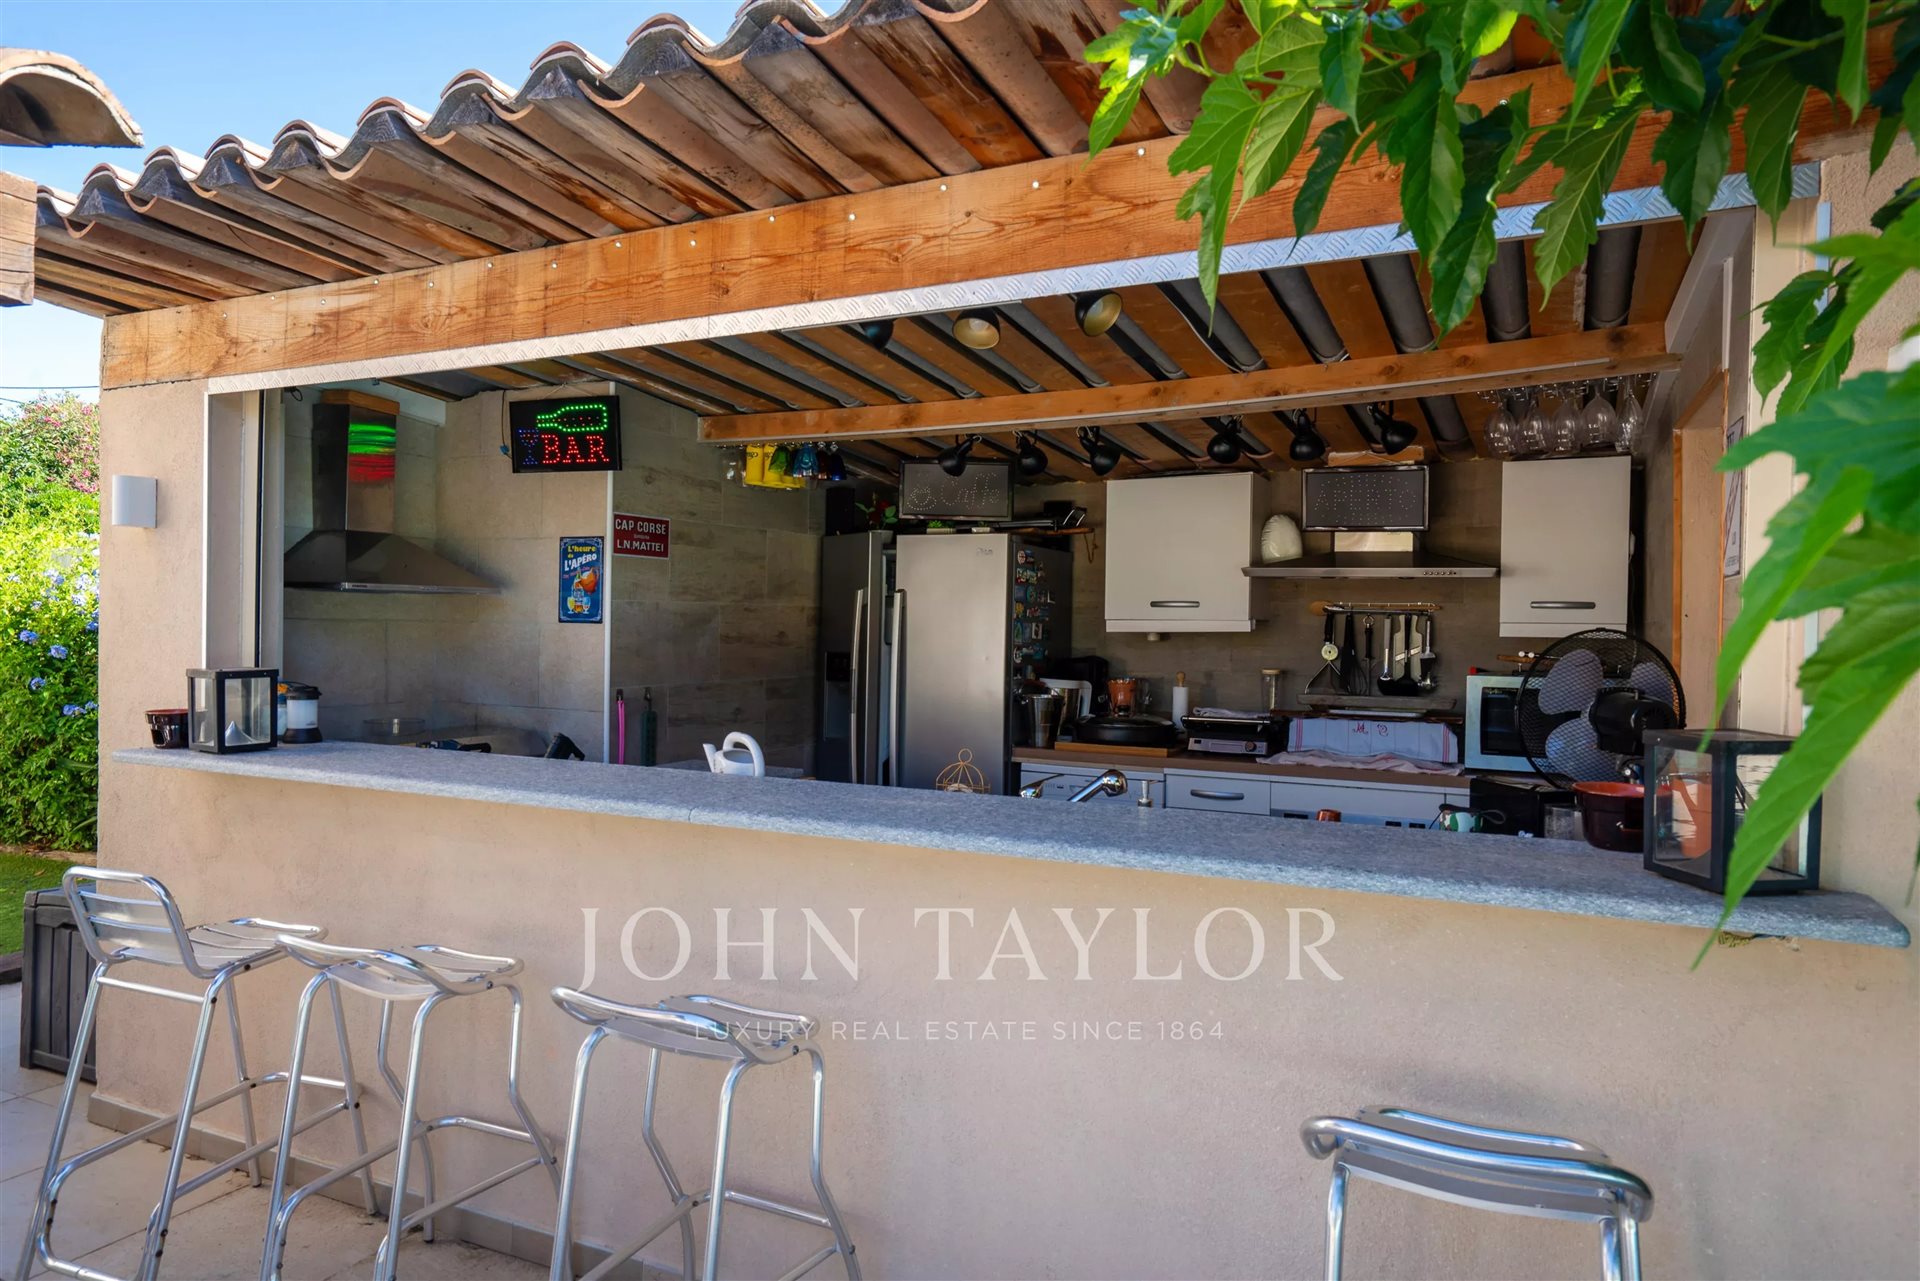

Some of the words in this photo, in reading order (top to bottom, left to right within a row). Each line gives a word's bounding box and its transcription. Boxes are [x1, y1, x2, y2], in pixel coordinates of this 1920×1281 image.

[541, 434, 609, 463] BAR
[615, 518, 635, 531] CAP
[637, 521, 667, 535] CORSE
[564, 553, 597, 572] L'APÉRO
